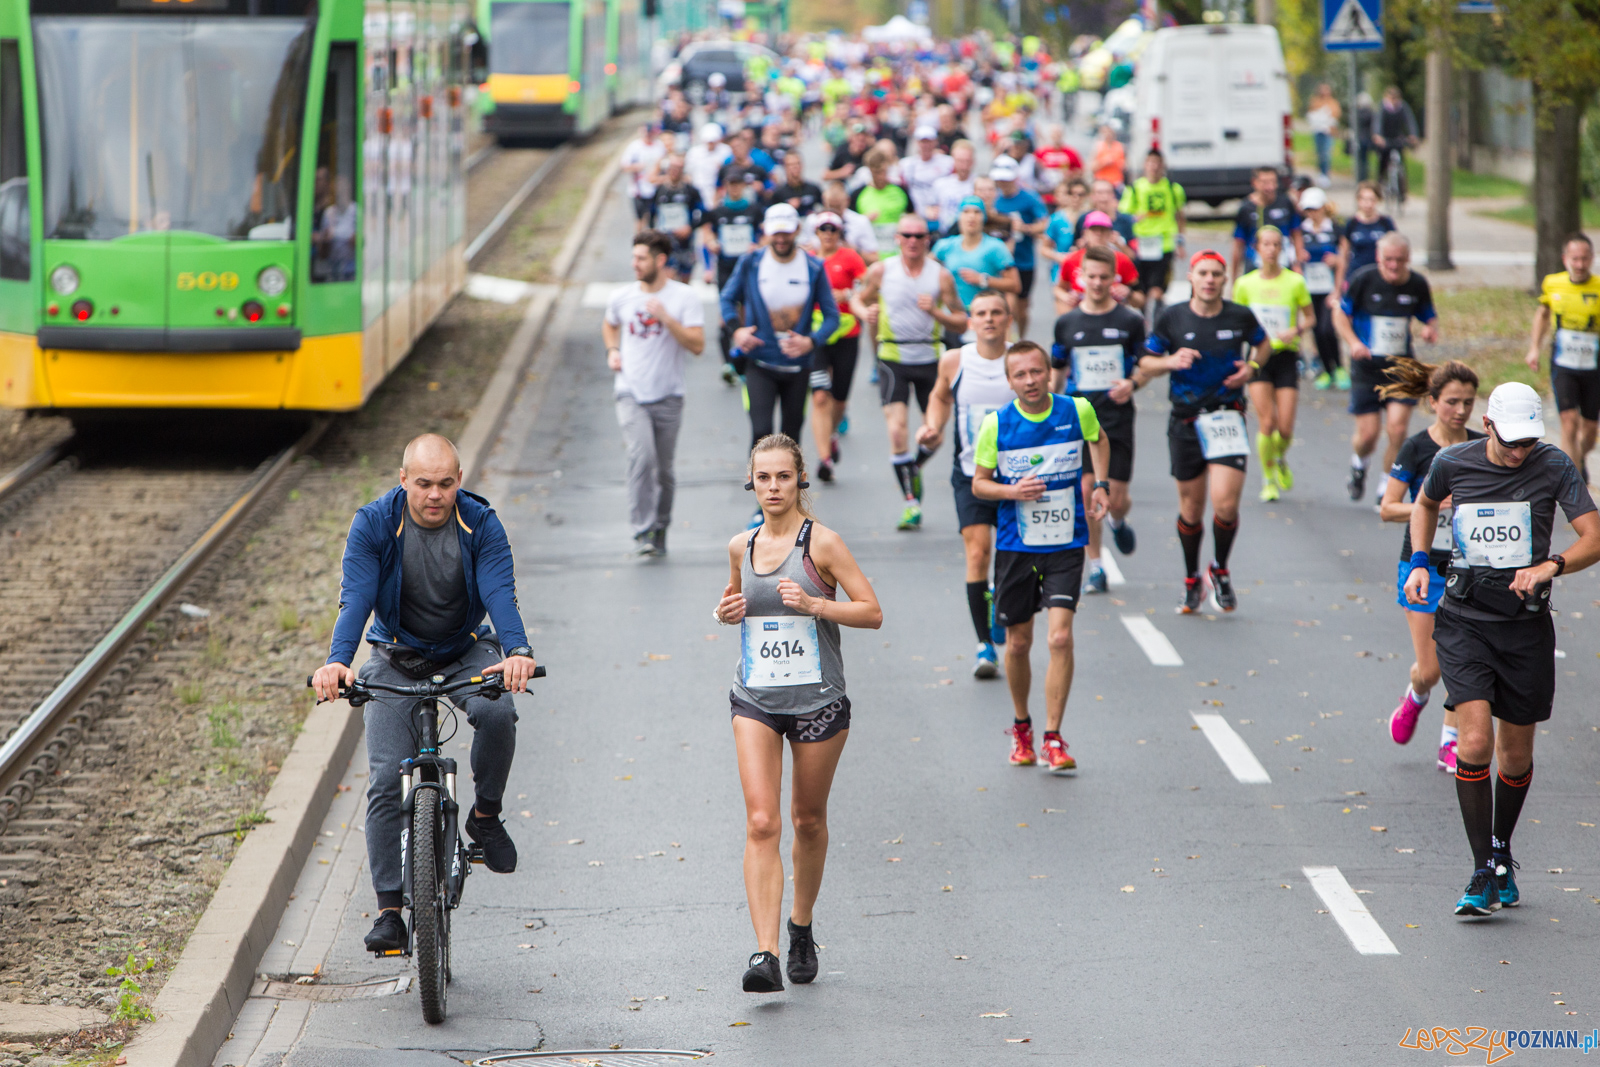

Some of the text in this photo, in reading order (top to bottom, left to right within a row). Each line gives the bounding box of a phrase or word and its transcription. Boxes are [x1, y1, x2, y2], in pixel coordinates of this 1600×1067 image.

[176, 271, 240, 291] 509
[1032, 508, 1070, 524] 5750
[1469, 525, 1521, 543] 4050
[760, 639, 805, 659] 6614
[800, 698, 843, 740] adida
